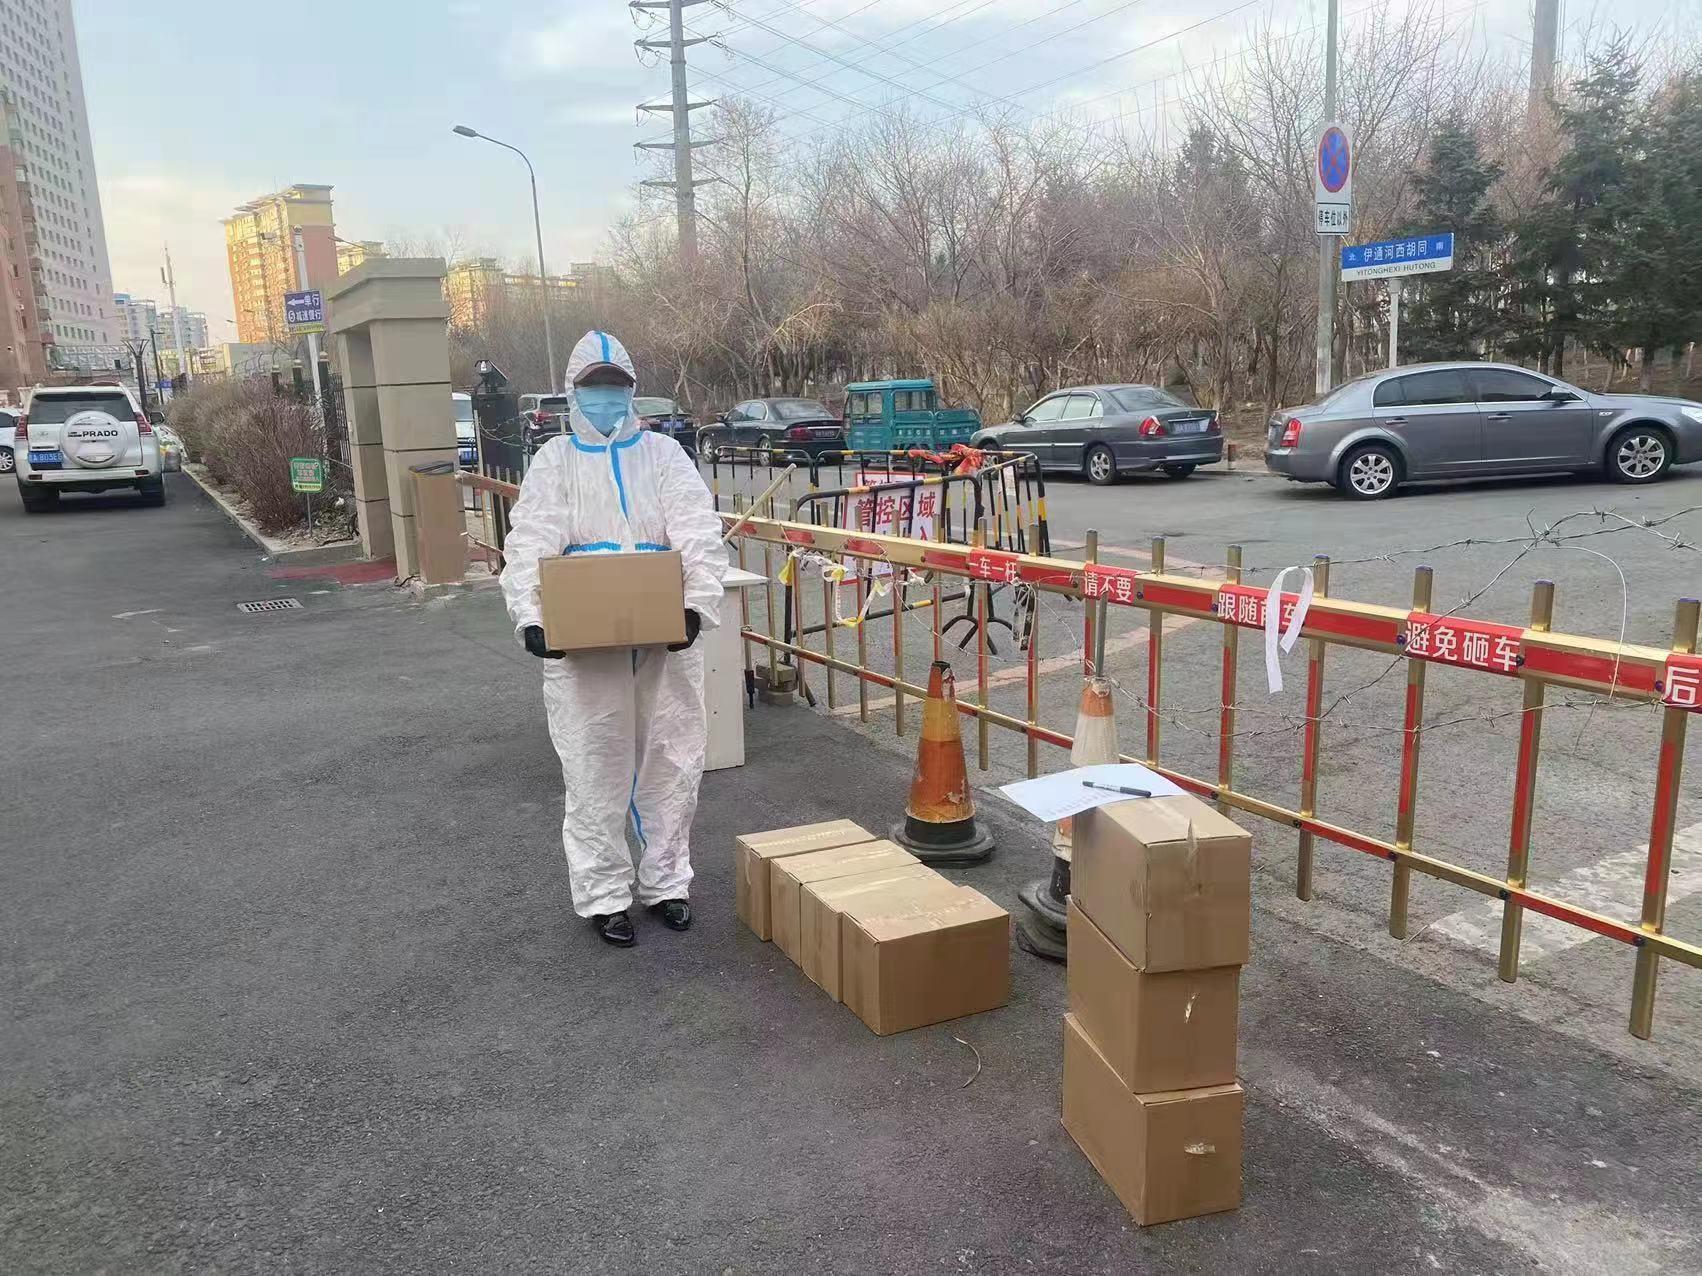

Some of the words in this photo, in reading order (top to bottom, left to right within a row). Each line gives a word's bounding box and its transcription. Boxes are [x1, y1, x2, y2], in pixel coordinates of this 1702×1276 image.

[1348, 252, 1357, 261] 北
[1364, 240, 1427, 262] 伊通河西胡同
[1357, 265, 1400, 276] YITONGHEXI
[1403, 261, 1436, 271] HUTONG
[82, 430, 118, 438] PRADO
[857, 490, 936, 527] 管控区域
[968, 556, 1018, 583] 一车一杆
[1084, 570, 1132, 603] 请不要
[1404, 620, 1520, 672] 避免砸车
[1663, 665, 1700, 705] 后
